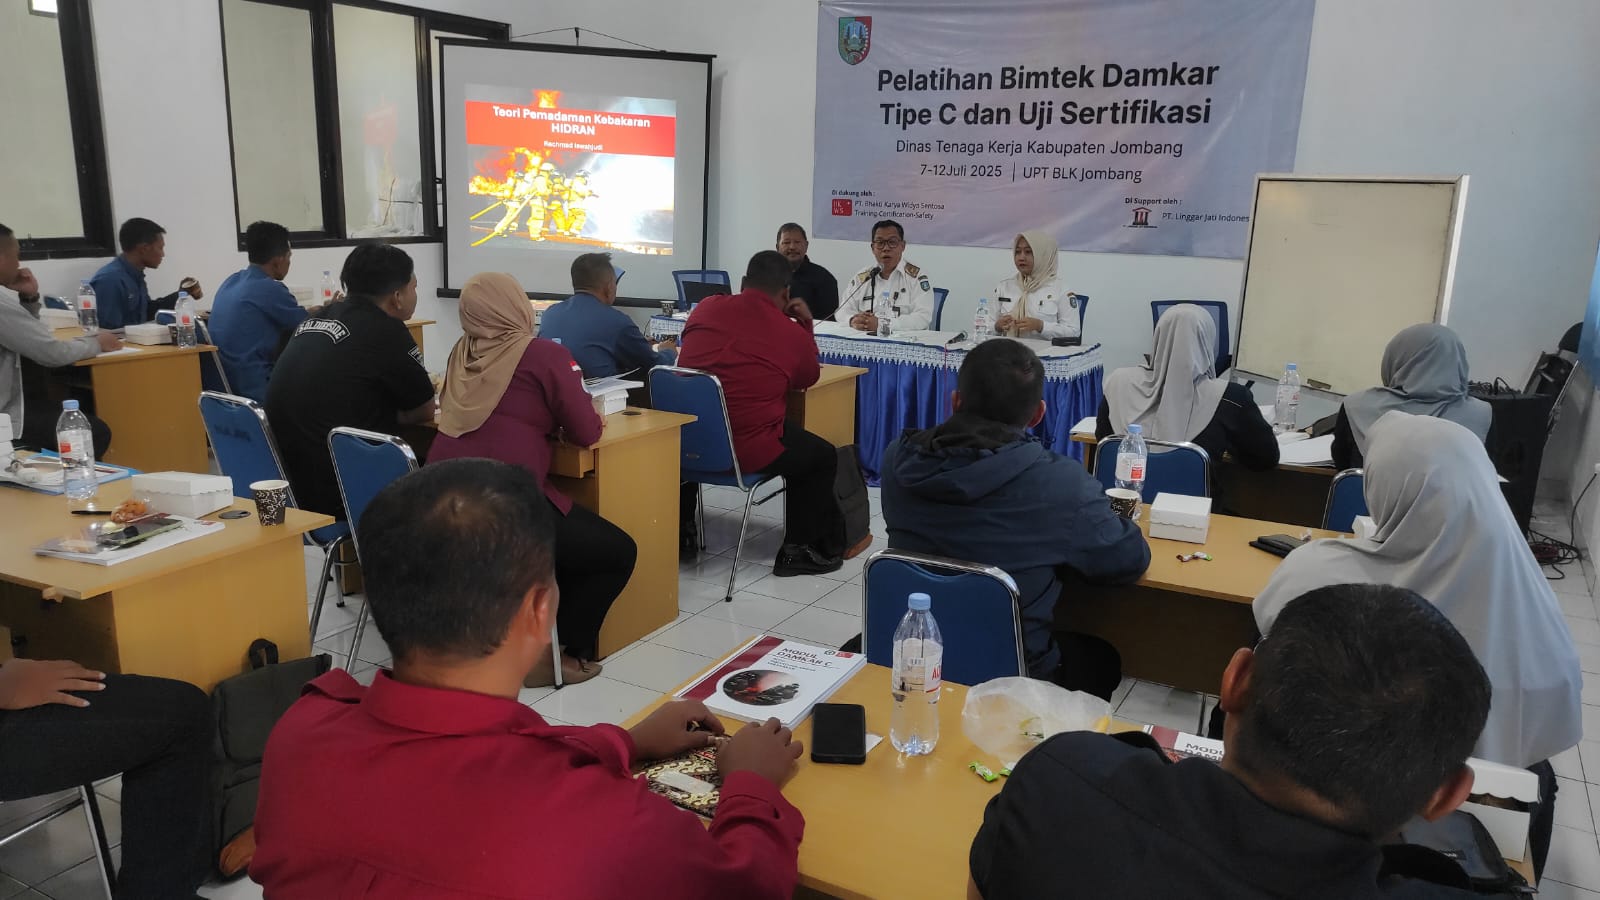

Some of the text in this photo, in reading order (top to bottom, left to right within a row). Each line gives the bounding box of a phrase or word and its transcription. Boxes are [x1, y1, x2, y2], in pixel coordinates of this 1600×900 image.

[878, 61, 1220, 92] Pelatihan Bimtek Damkar
[492, 105, 651, 128] Teori Pemadaman Kebakaran
[879, 98, 1212, 131] Tipe C dan Uji Sertifikasi
[551, 123, 595, 136] HIDRAN
[896, 139, 1183, 158] Dinas Tenaga Kerja Kabupaten Jombang
[970, 165, 1002, 177] 2025
[1023, 166, 1050, 179] UPT
[1052, 167, 1078, 180] BLK
[1079, 167, 1142, 184] Jombang
[838, 189, 860, 197] dukung
[884, 201, 900, 210] Karya
[901, 202, 920, 210] Widya
[920, 202, 945, 210] Sentosa
[1133, 197, 1162, 206] Support
[1162, 212, 1250, 223] PT. Linggar Jati Indones
[777, 651, 823, 665] DAMKAR
[781, 647, 818, 659] MODUL
[1186, 743, 1224, 757] MOD
